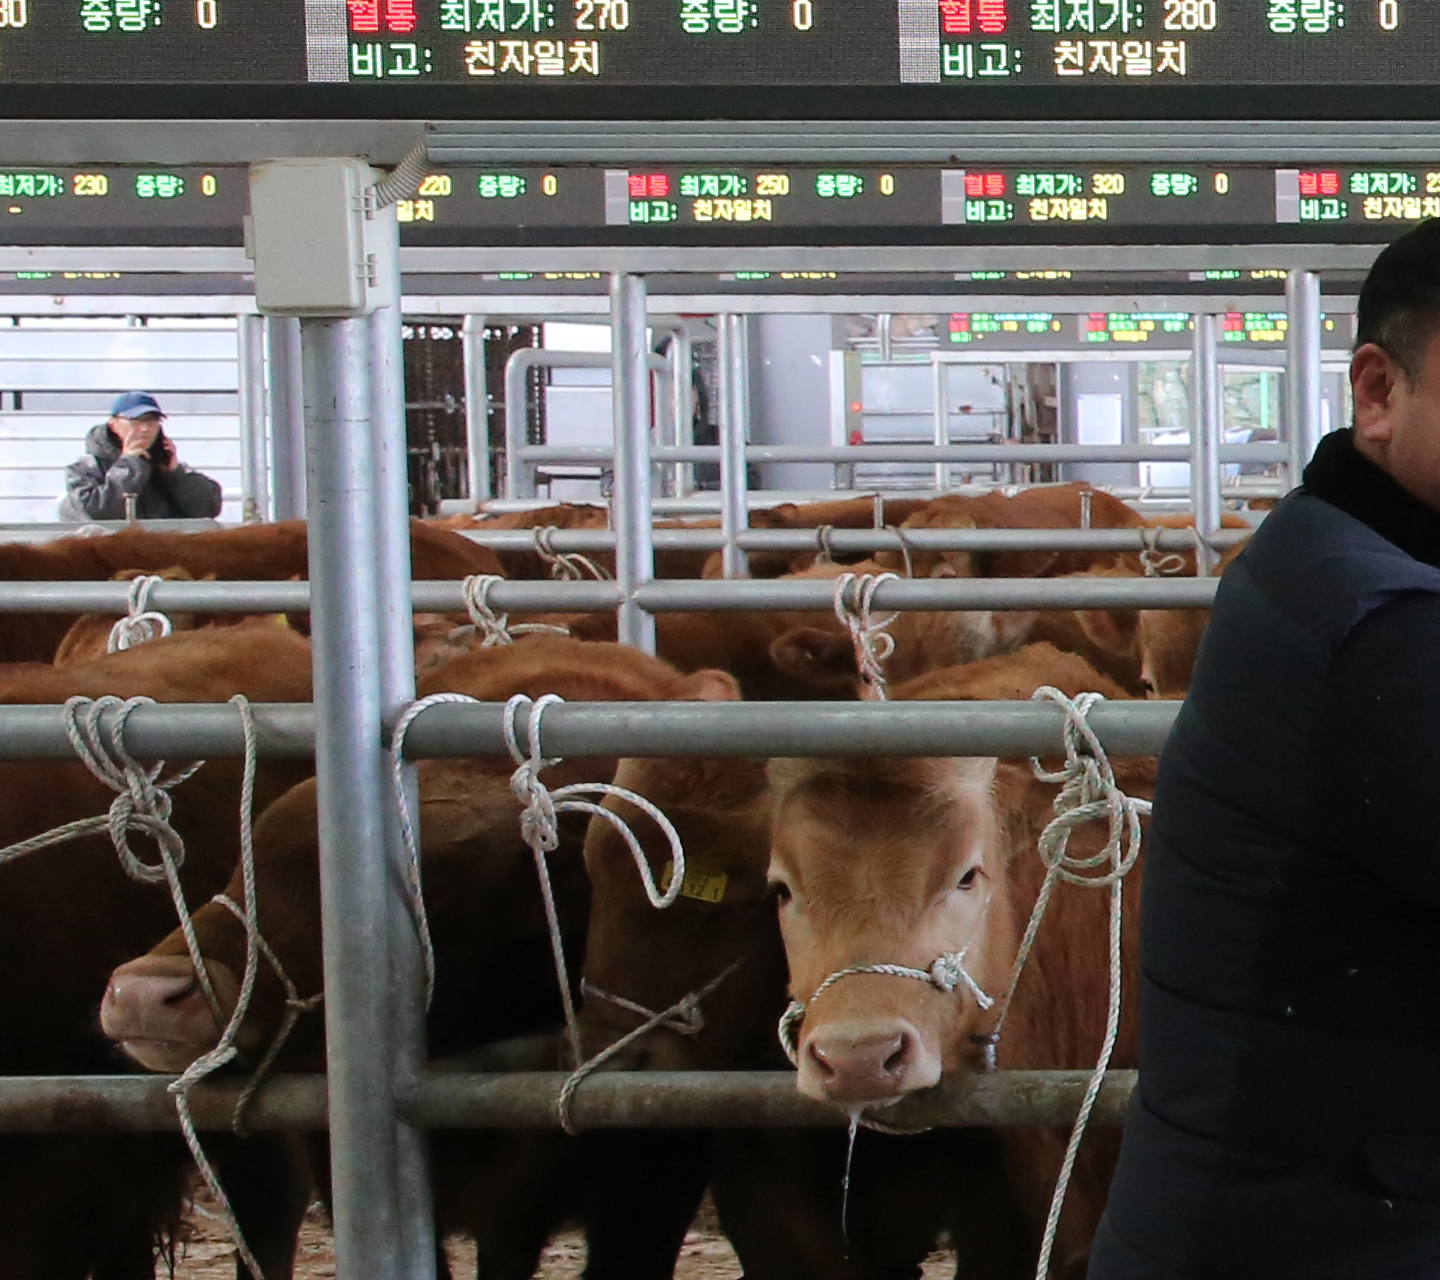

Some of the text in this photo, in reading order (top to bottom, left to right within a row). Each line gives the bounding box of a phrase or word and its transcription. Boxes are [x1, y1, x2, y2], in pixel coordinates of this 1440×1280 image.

[351, 40, 599, 78] 비고: 친자일치
[943, 40, 1186, 79] 비고: 친자일치
[72, 174, 216, 196] 230 0
[680, 174, 894, 197] 최저가: 250 0
[627, 201, 677, 223] 비고:
